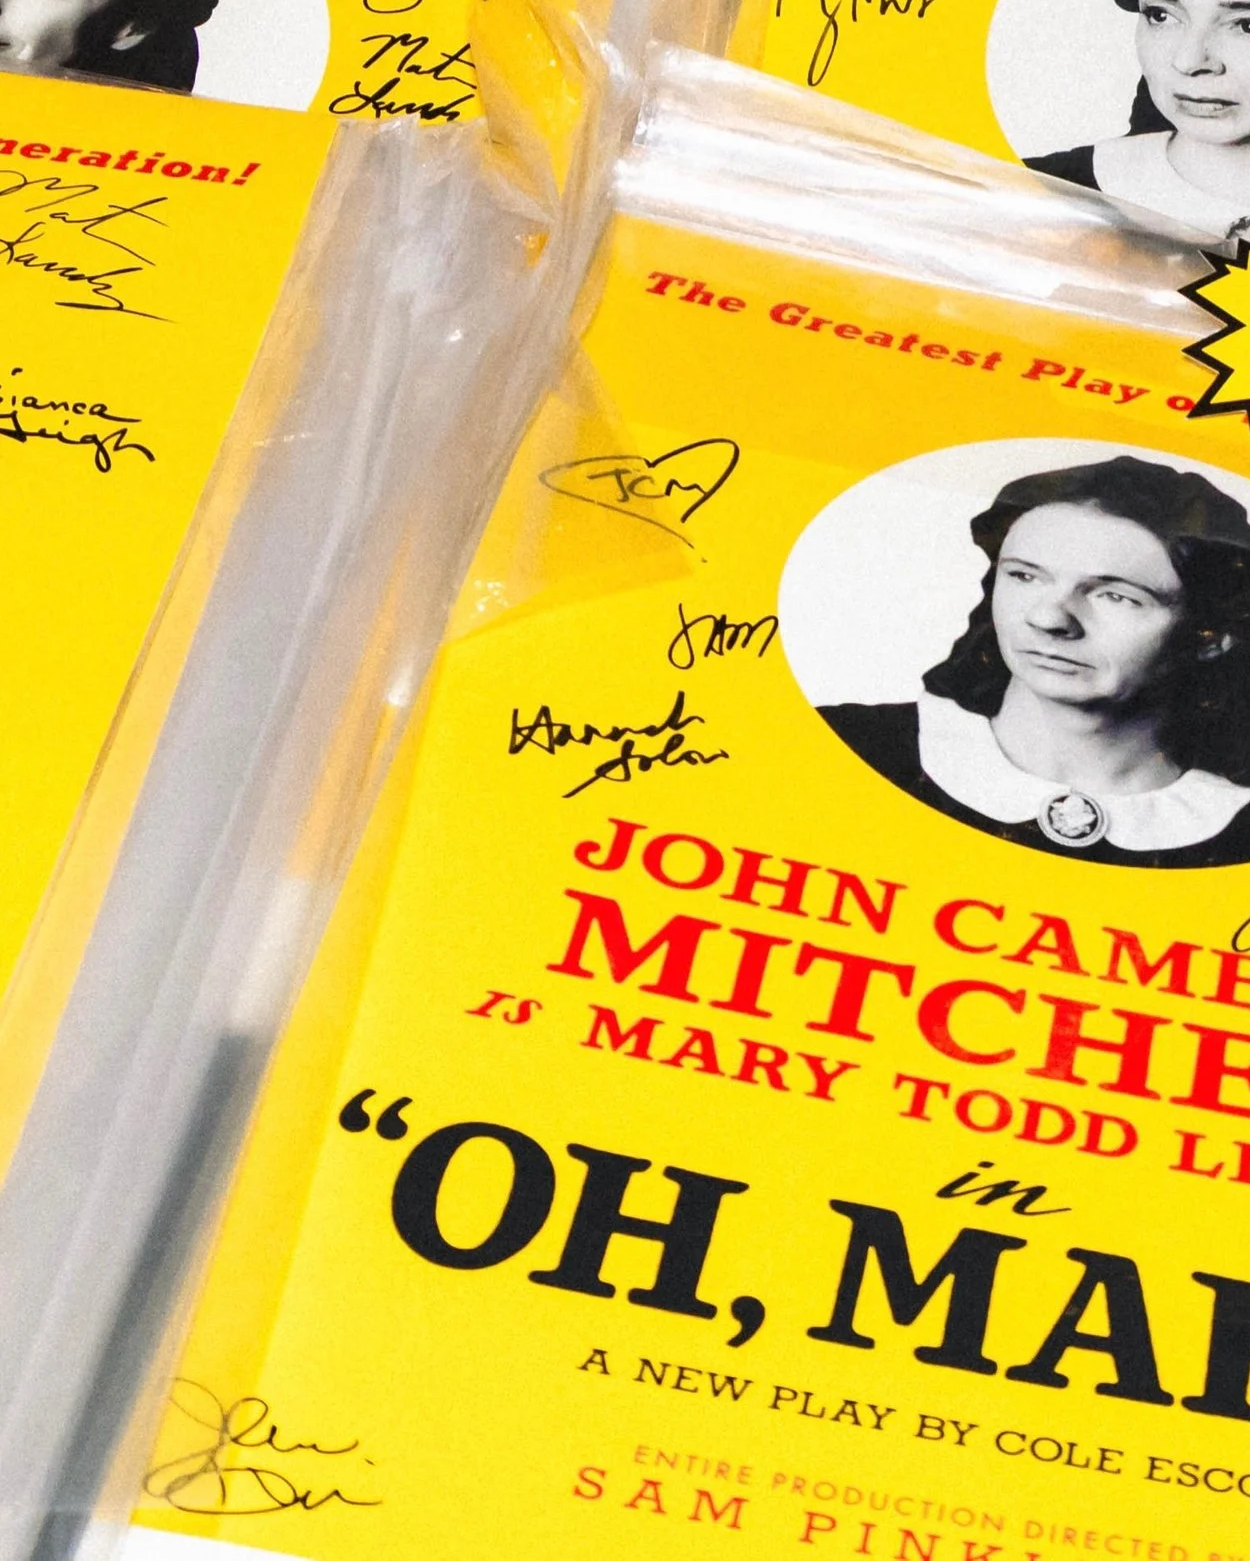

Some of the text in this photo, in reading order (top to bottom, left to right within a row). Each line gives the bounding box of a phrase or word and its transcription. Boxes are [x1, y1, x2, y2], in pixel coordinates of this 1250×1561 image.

[0, 138, 260, 186] neration!
[0, 367, 142, 422] ianca
[646, 271, 1197, 413] The Greatest Play o
[573, 817, 906, 935] JOHN
[467, 990, 543, 1025] IS
[581, 1004, 860, 1102] MARY
[893, 1073, 1139, 1158] TODD
[936, 1160, 1071, 1216] in
[577, 1348, 611, 1376] A
[633, 1357, 753, 1402] NEW
[767, 1385, 897, 1431] PLAY
[915, 1414, 978, 1447] BY
[995, 1431, 1124, 1475] COLE
[571, 1466, 750, 1531] SAM
[633, 1444, 1190, 1561] ENTIRE PRODUCTION DIRECTED
